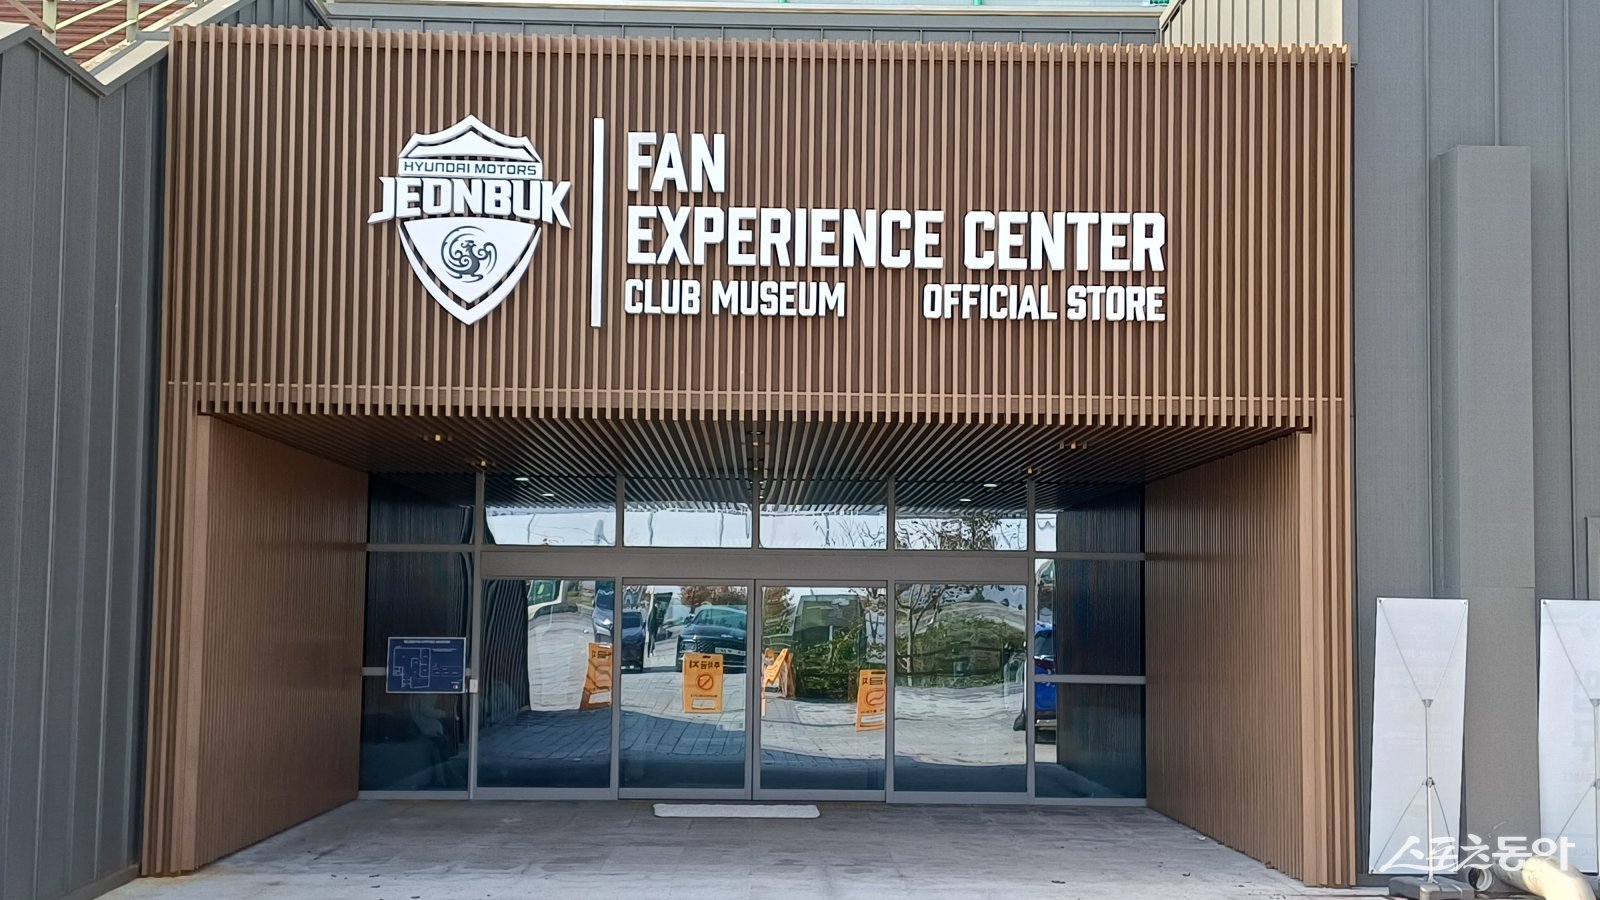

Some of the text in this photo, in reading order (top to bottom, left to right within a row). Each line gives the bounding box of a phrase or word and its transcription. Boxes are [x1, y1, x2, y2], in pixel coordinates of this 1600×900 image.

[404, 161, 537, 176] HYUNDAI MOTORS
[627, 131, 726, 194] FAN
[367, 175, 572, 229] JEONBUK
[626, 205, 1166, 273] EXPERIENCE CENTER
[624, 278, 846, 318] CLUB MUSEUM
[923, 283, 1166, 323] OFFICIAL STORE
